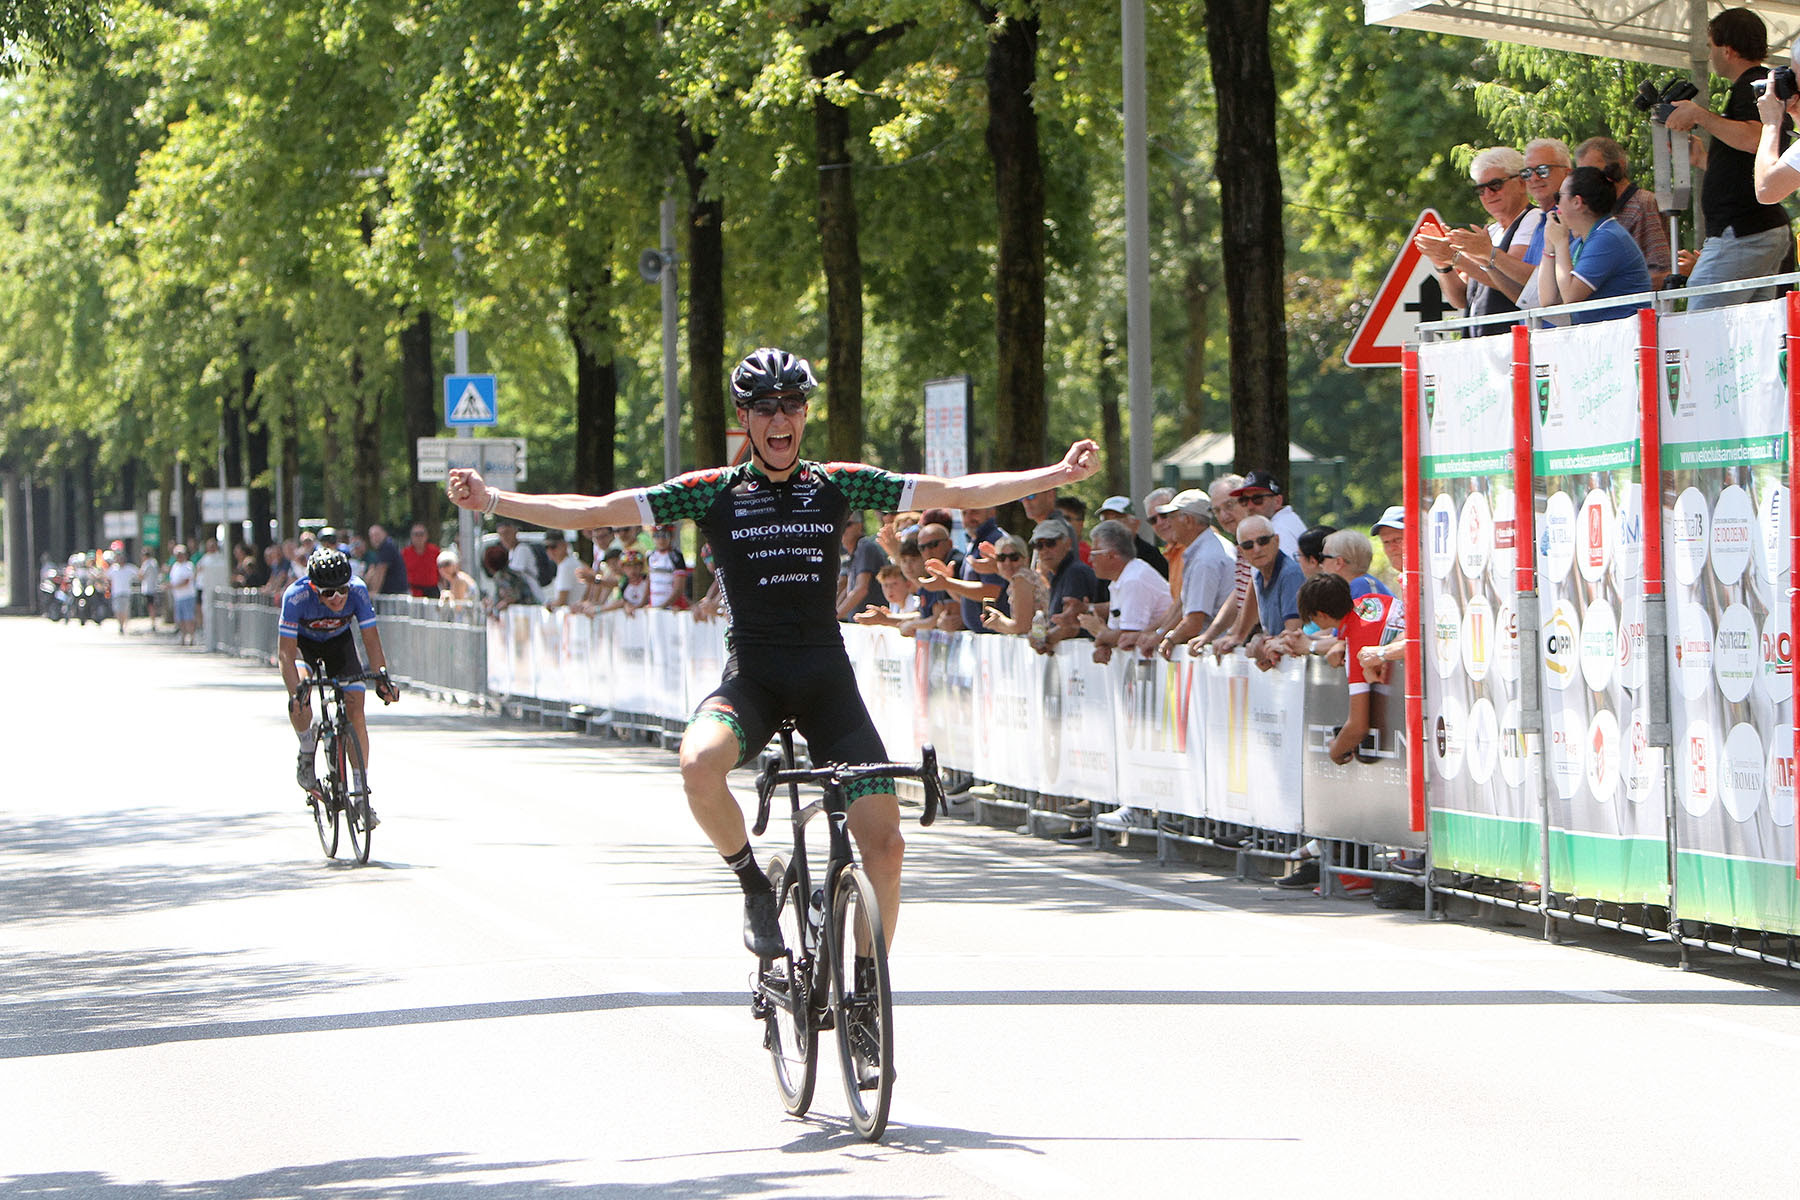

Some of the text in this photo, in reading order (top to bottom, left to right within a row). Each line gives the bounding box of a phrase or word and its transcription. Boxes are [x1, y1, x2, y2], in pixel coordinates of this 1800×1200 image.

[731, 523, 834, 540] BORGO MOLINO
[747, 548, 785, 559] VIGNA
[770, 573, 809, 584] RAINOX
